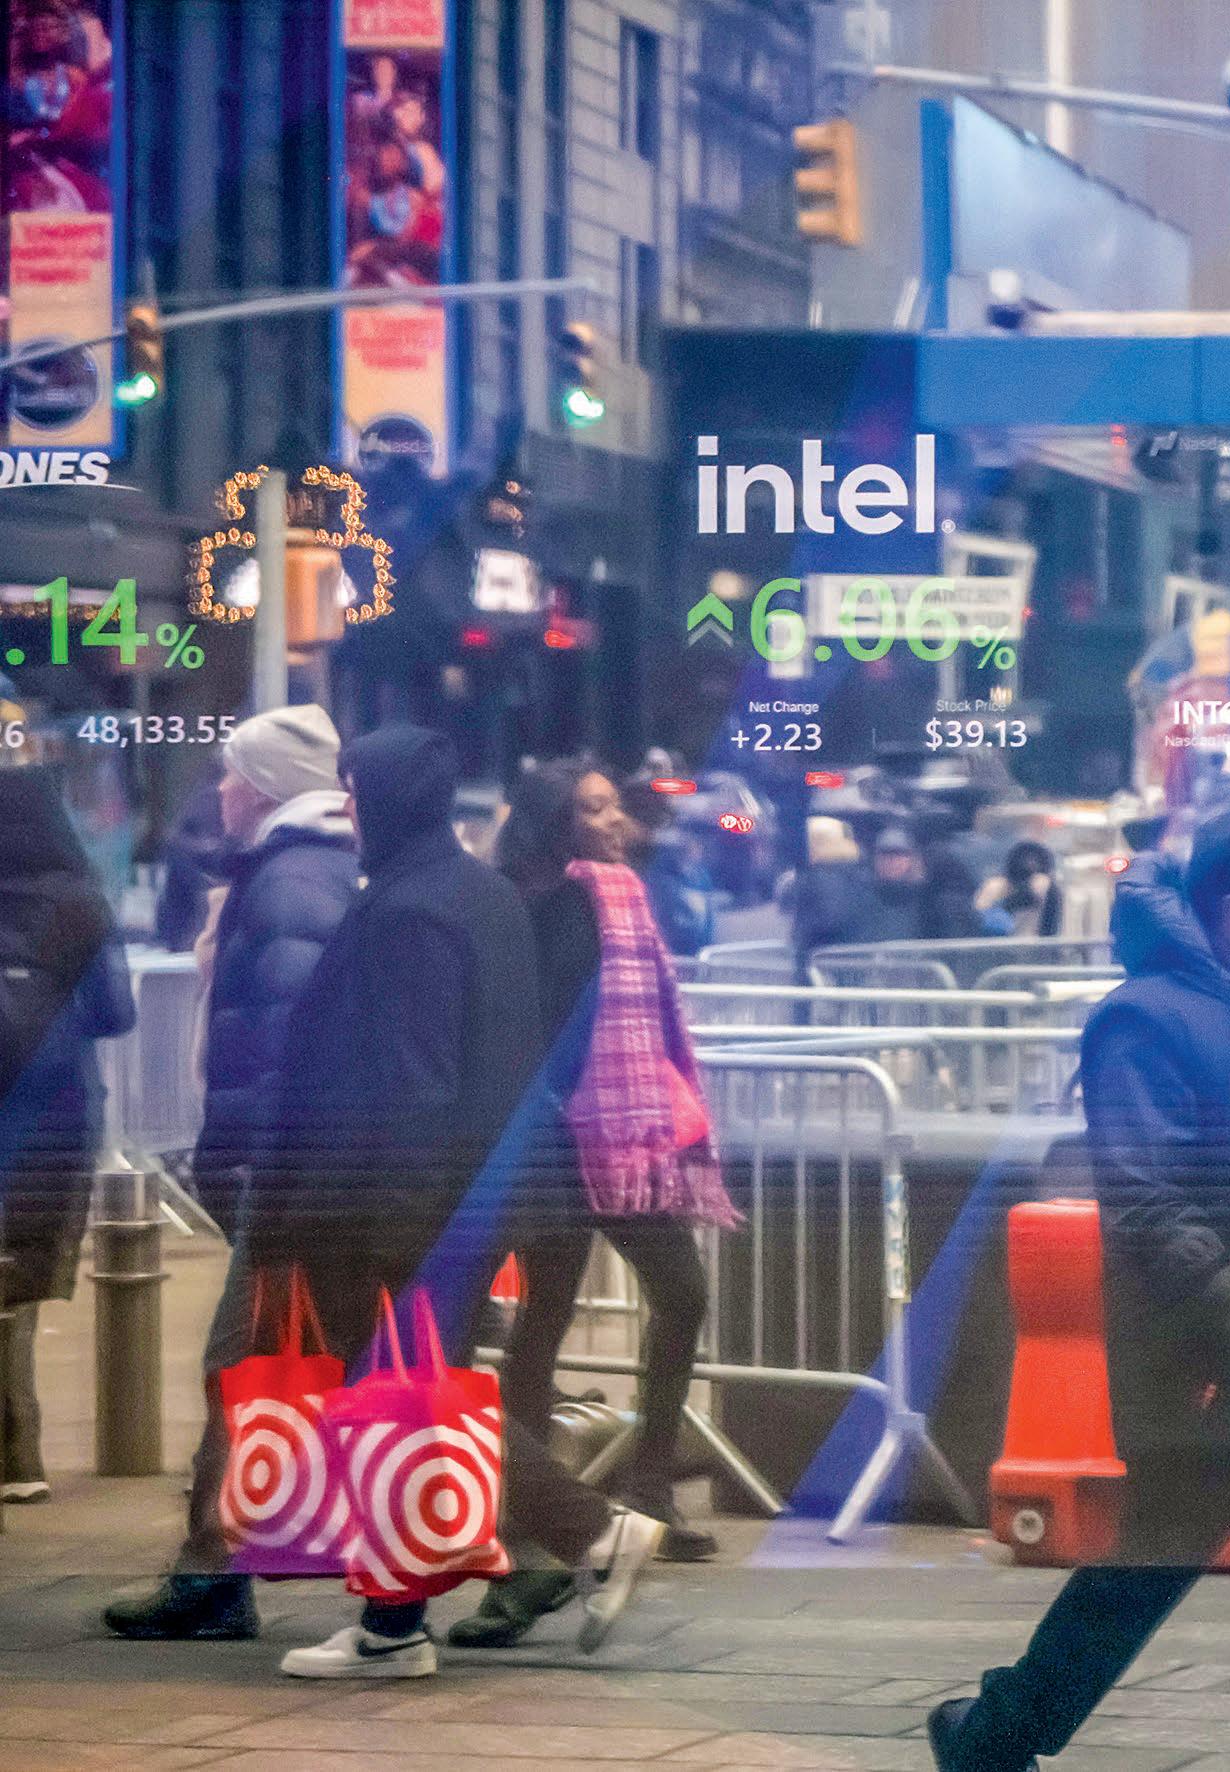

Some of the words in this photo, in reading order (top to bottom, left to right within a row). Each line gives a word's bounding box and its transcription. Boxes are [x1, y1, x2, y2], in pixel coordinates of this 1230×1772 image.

[749, 701, 771, 713] Net
[773, 700, 820, 715] Change
[936, 699, 971, 712] Stock
[975, 699, 1006, 712] Price
[0, 720, 26, 749] 6
[76, 715, 237, 749] 48,133.55
[730, 723, 823, 751] +2.23
[925, 717, 1028, 751] $39.13
